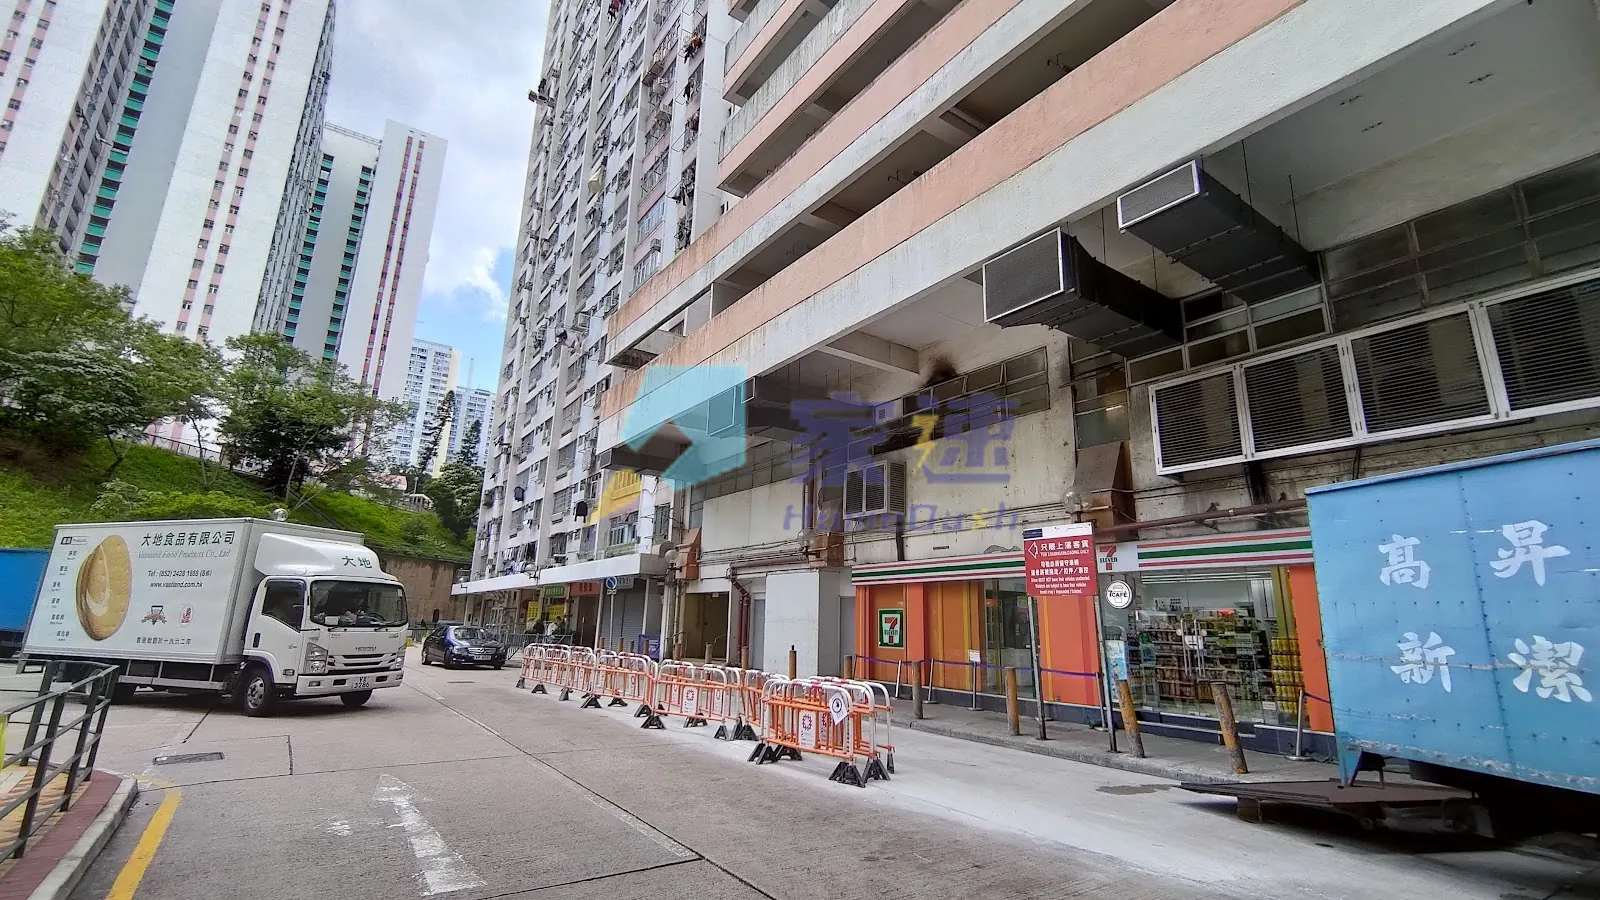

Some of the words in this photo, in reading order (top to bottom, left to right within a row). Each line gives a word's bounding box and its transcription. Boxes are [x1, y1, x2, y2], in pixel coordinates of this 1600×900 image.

[141, 531, 236, 546] 大地食品有限公司
[1040, 540, 1089, 552] 只限上落客貨
[341, 555, 373, 569] 大地
[159, 569, 173, 577] (852)
